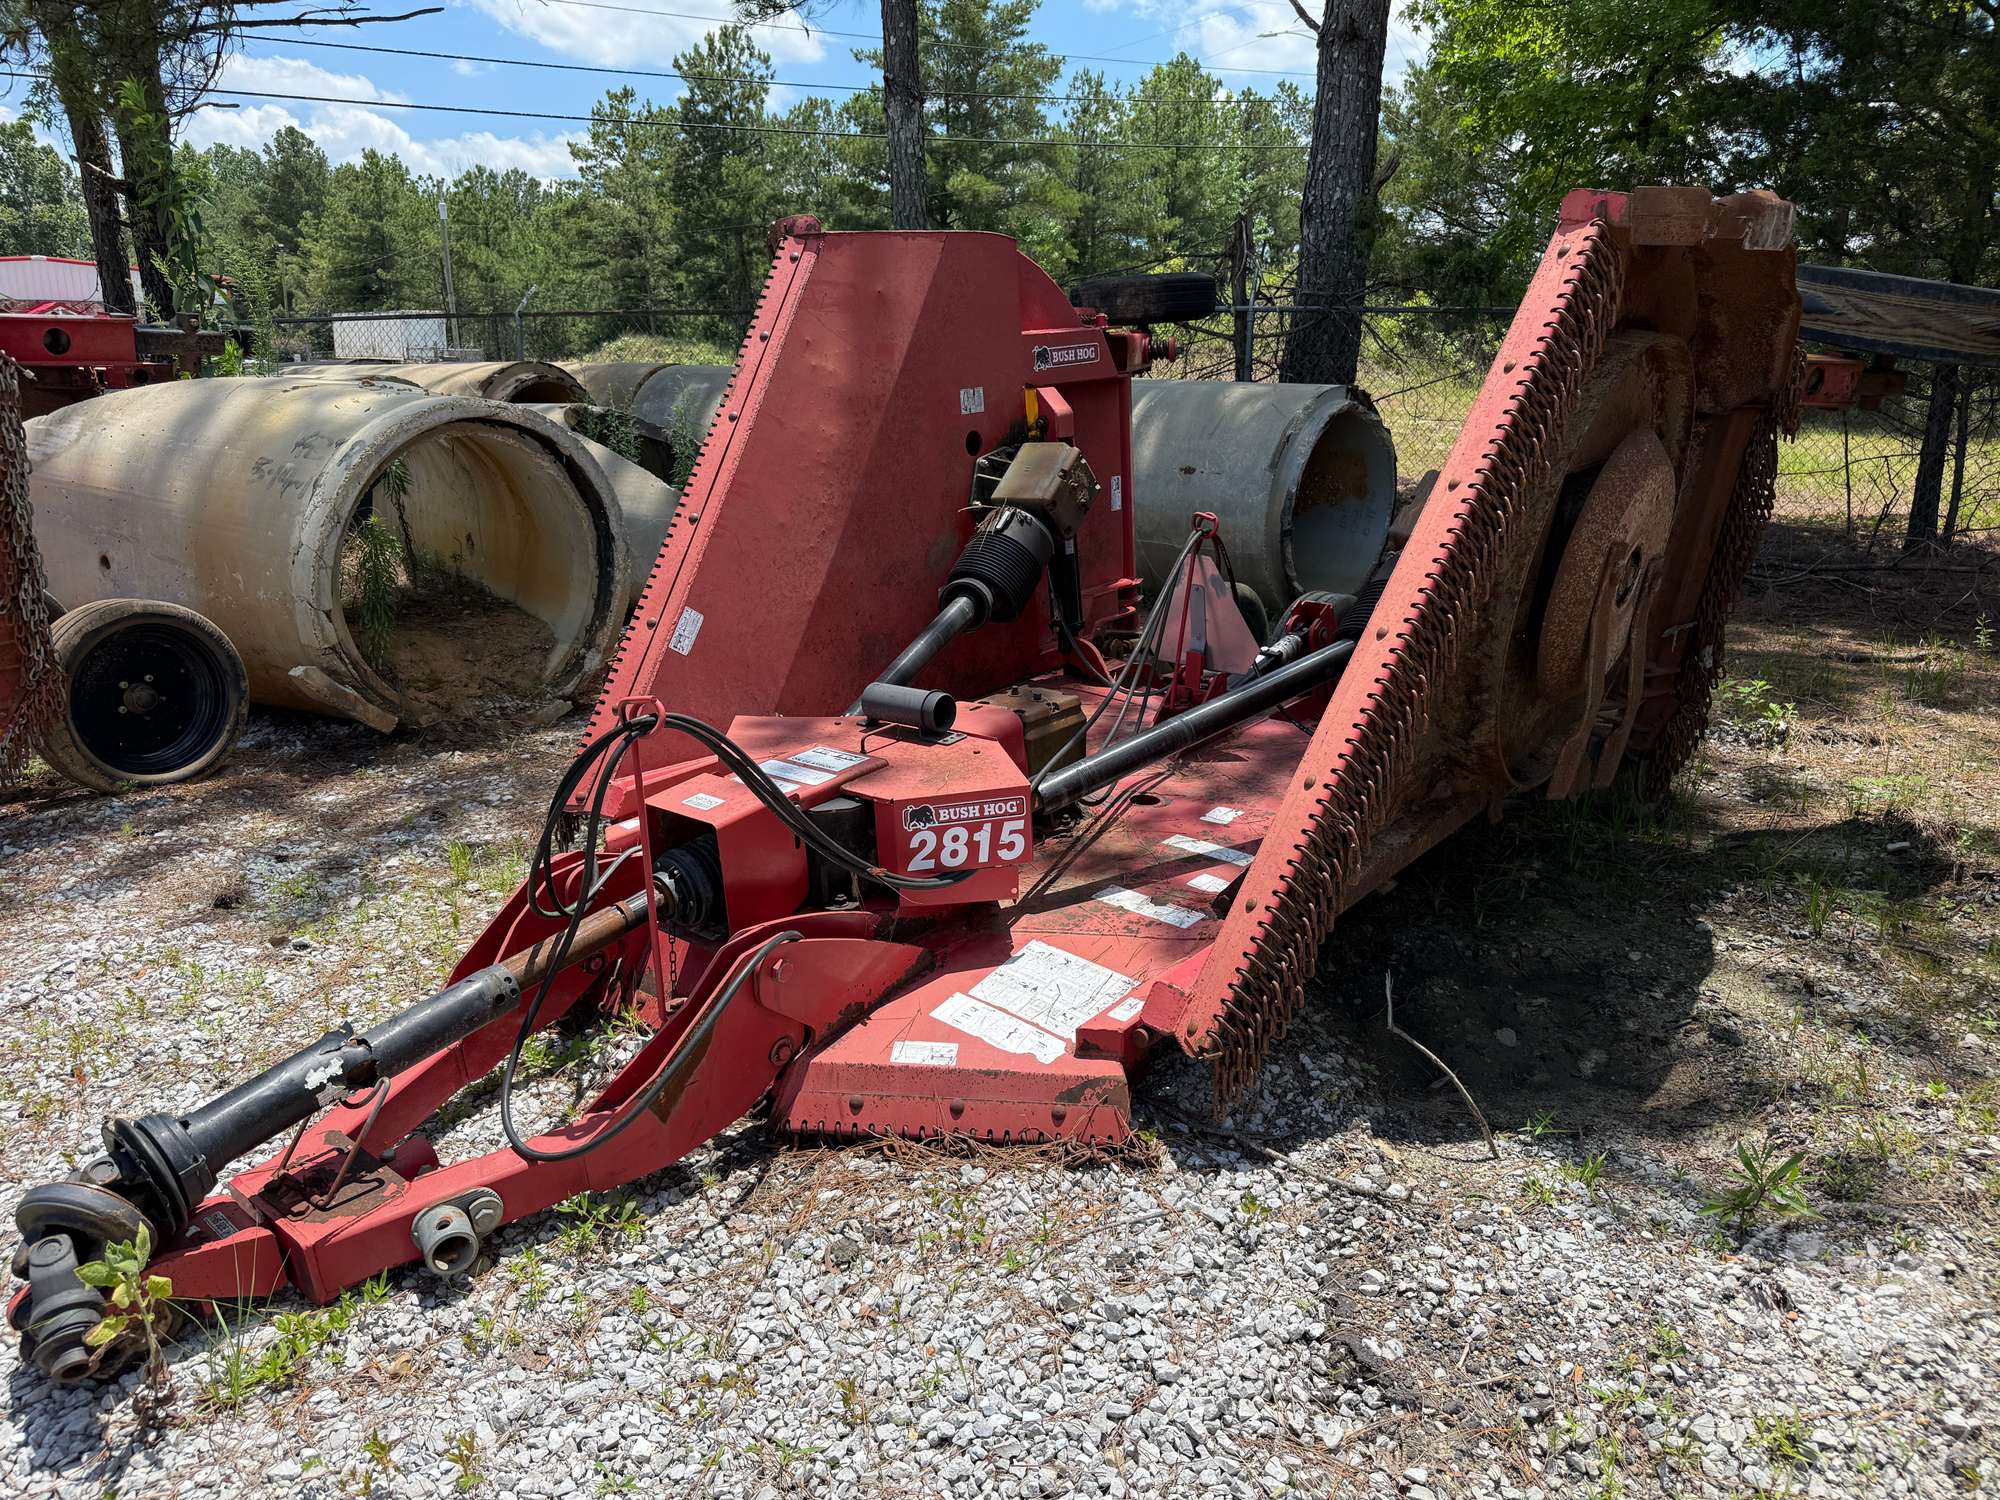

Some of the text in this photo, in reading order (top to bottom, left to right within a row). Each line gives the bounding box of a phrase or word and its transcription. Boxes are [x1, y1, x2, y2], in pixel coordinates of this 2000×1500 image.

[1052, 347, 1095, 362] BUSH HOG
[939, 801, 1017, 820] BUSH HOG
[907, 820, 1024, 871] 2815
